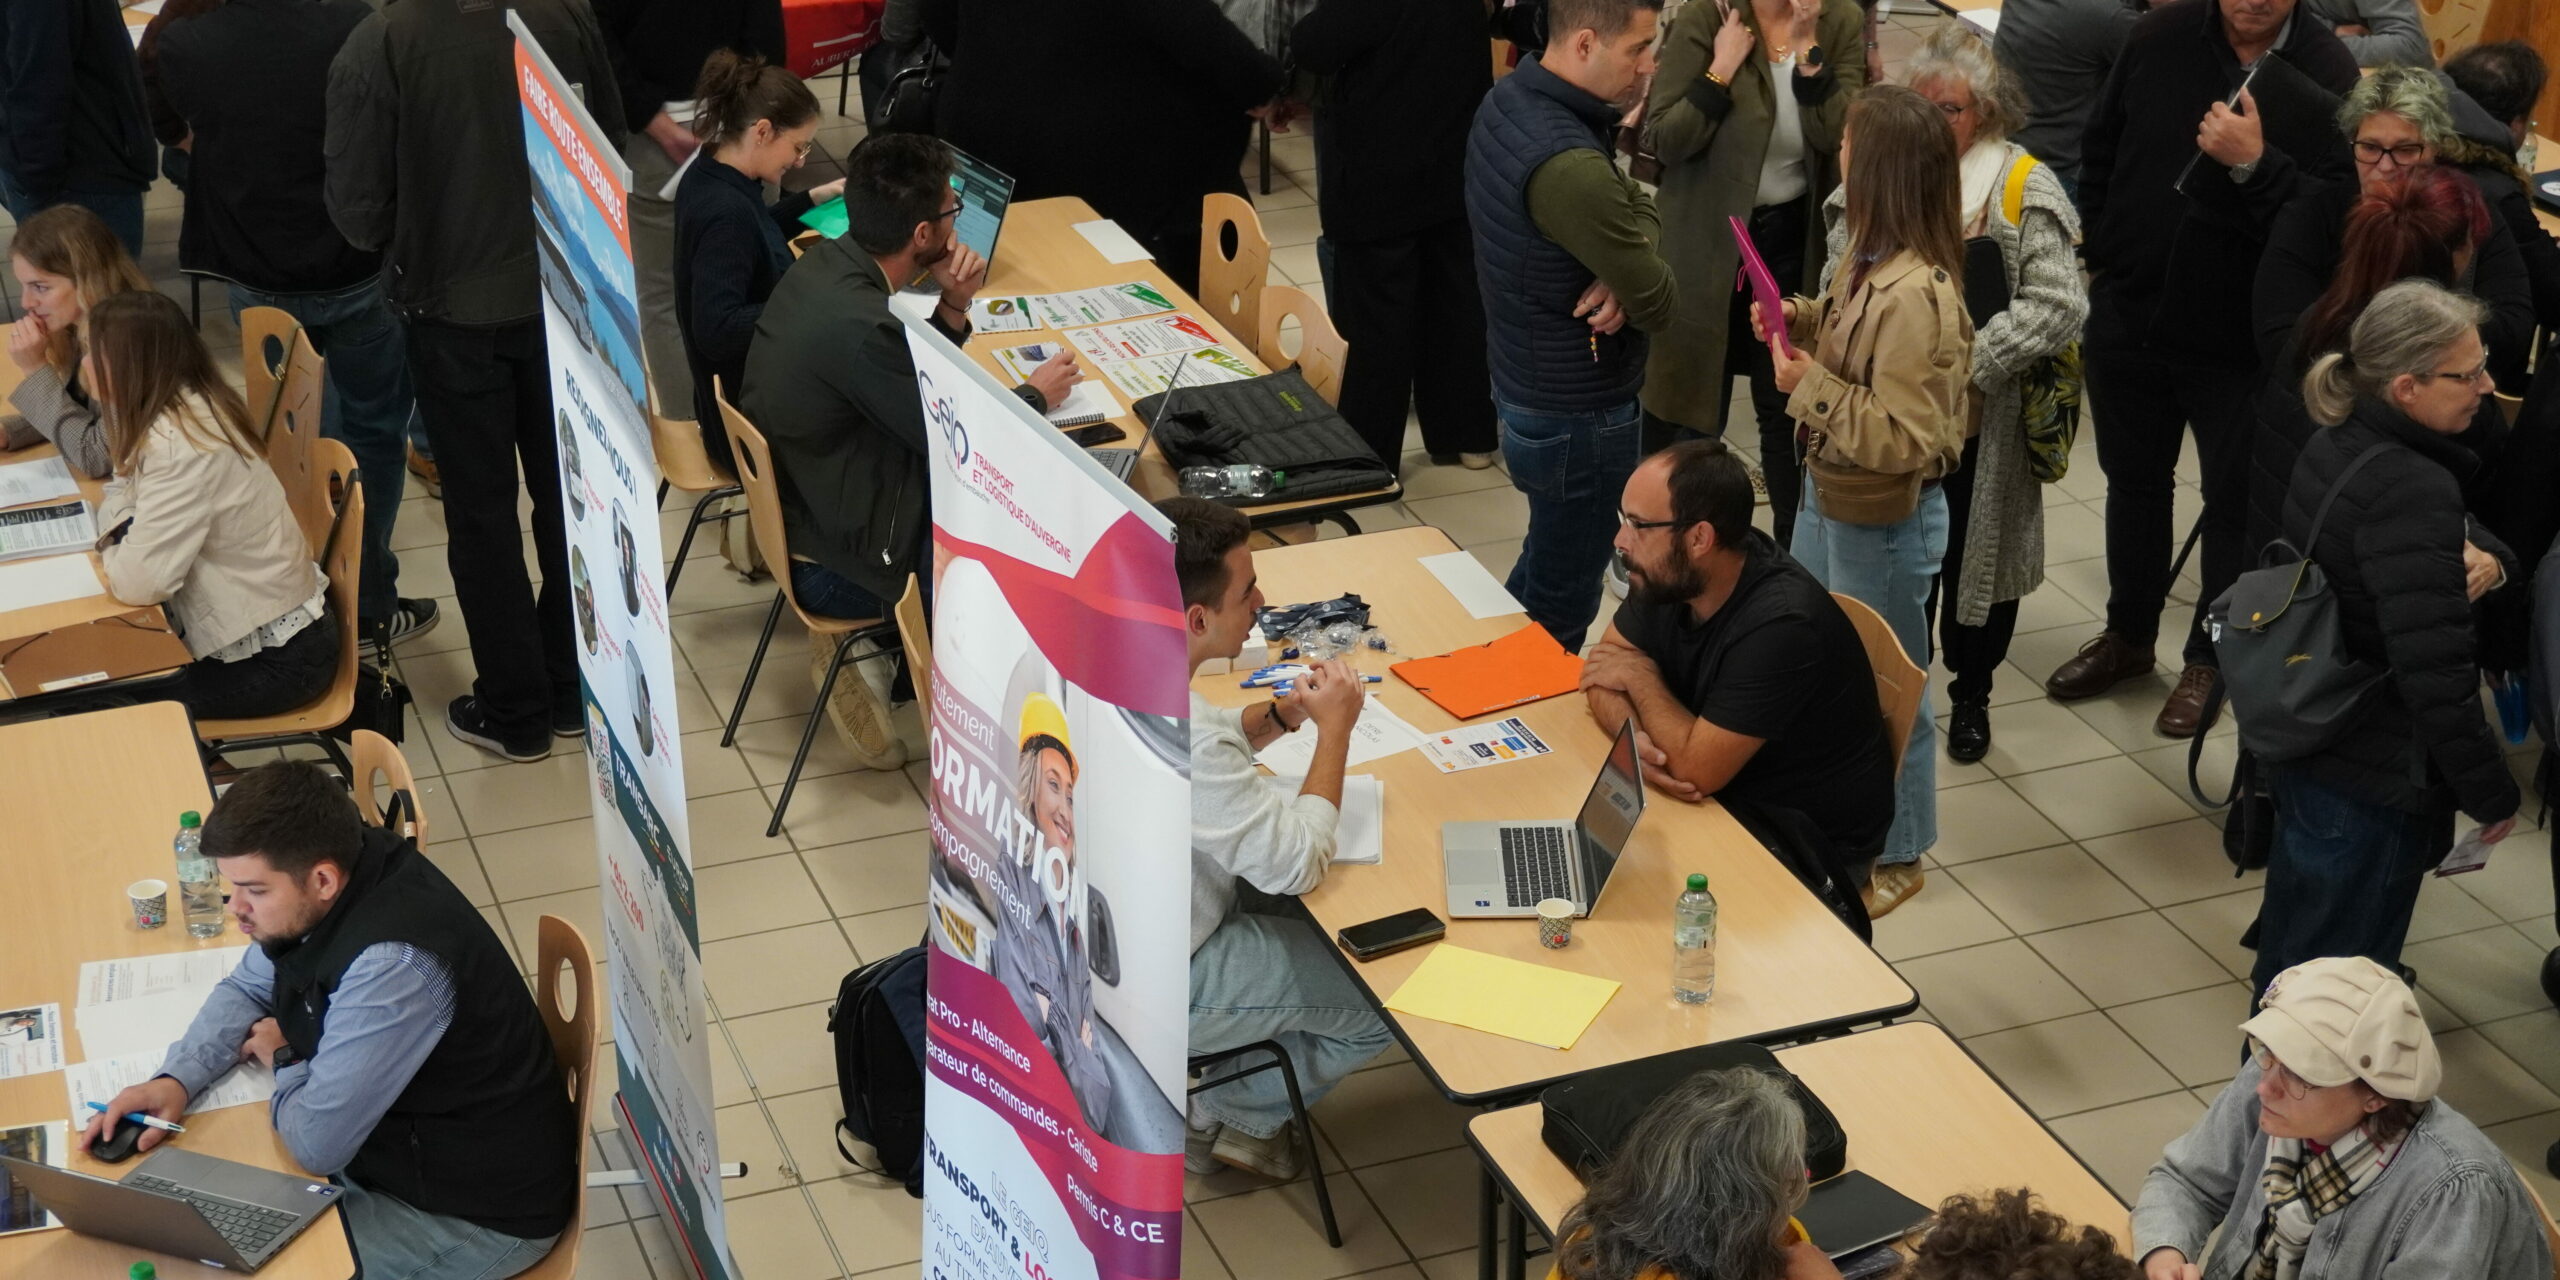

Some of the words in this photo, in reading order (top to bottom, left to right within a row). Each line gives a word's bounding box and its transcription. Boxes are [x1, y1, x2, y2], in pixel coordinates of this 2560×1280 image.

[523, 65, 548, 120] FAIRE
[548, 99, 578, 162] ROUTE
[577, 140, 623, 231] ENSEMBLE
[973, 469, 983, 486] ET
[985, 476, 1024, 523] LOGISTIQUE
[1025, 513, 1071, 563] D'AUVERGNE
[974, 451, 1014, 496] TRANSPORT
[614, 750, 662, 849] TRANSARC
[930, 712, 1088, 931] ORMATION
[940, 1000, 960, 1028] Pro
[971, 1018, 1031, 1073] Alternance
[926, 1036, 969, 1078] parateur
[971, 1064, 987, 1087] de
[989, 1077, 1059, 1137] commandes
[1067, 1127, 1098, 1173] Cariste
[924, 1127, 1007, 1242] TRANSPORT
[1011, 1235, 1021, 1262] &
[1025, 1250, 1054, 1280] LO
[992, 1170, 1007, 1212] LE
[1010, 1199, 1049, 1264] GEIQ
[1067, 1172, 1099, 1221] Permis
[1100, 1207, 1110, 1230] C
[1113, 1214, 1126, 1237] &
[1130, 1221, 1165, 1243] CE
[935, 1241, 951, 1268] AU
